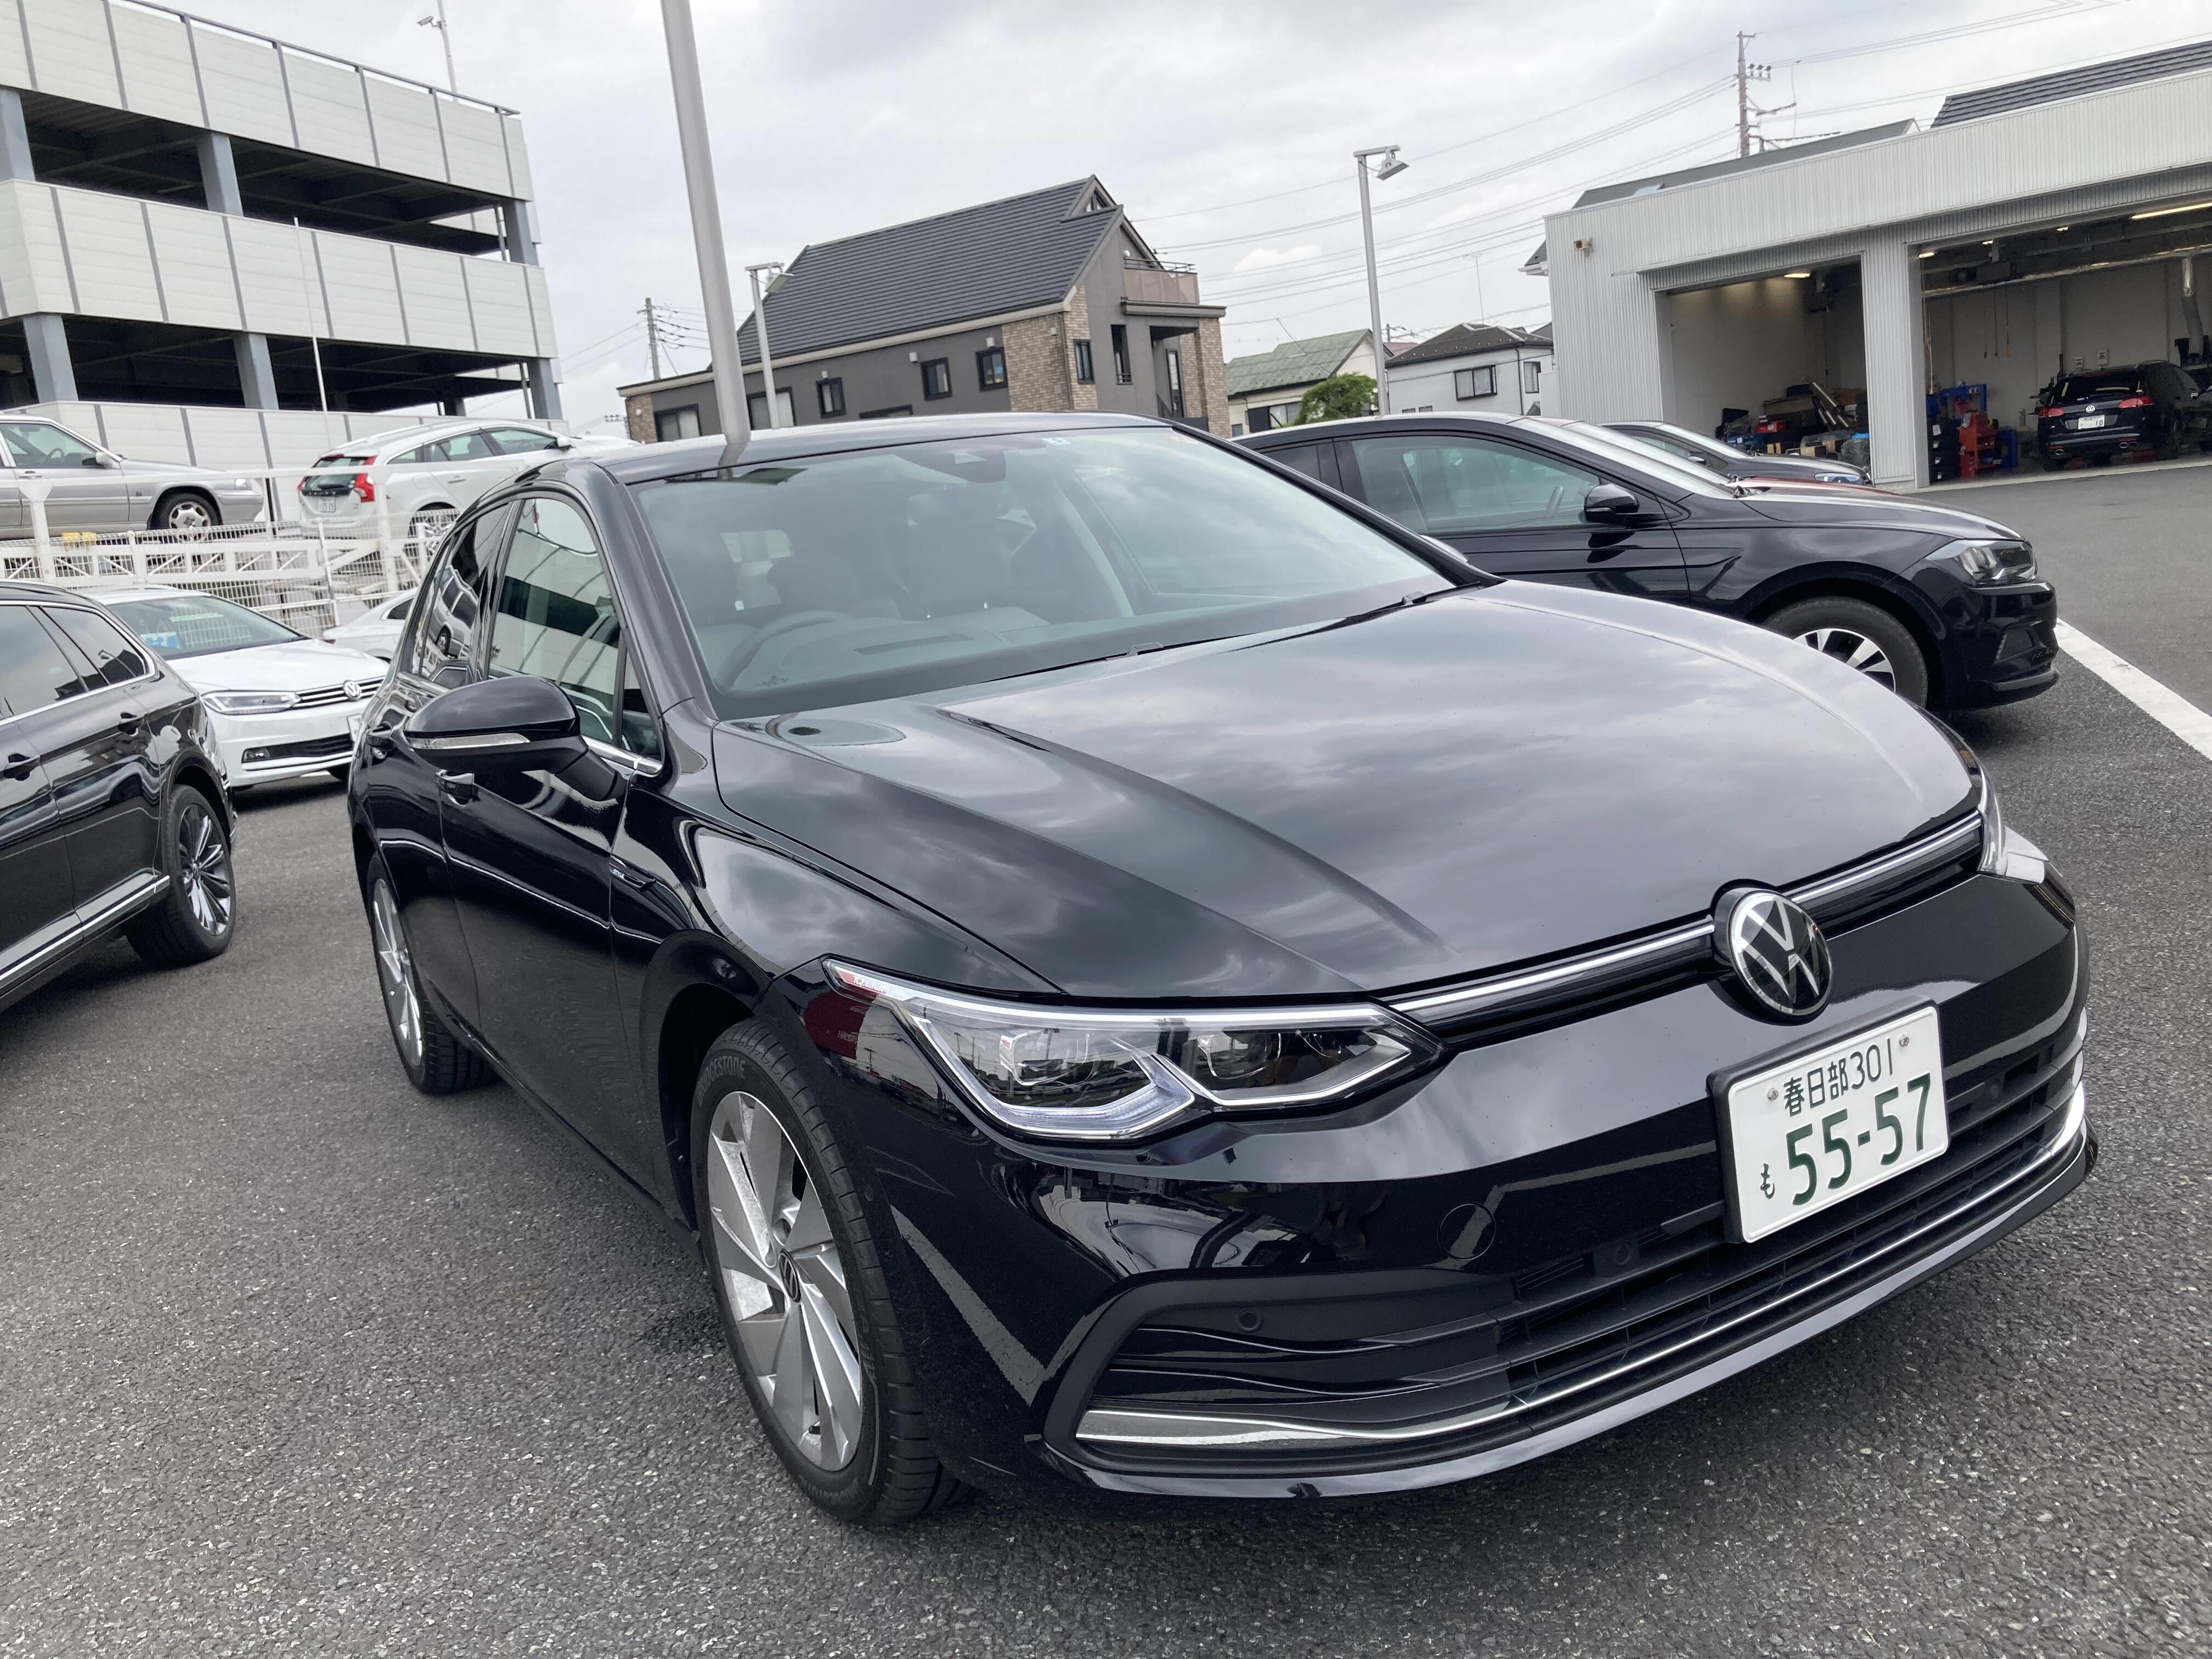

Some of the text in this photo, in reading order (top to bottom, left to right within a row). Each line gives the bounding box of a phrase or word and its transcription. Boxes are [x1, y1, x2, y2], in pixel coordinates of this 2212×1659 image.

[693, 1055, 746, 1108] BRIDGESTONE
[1784, 1037, 1894, 1118] 春日部301
[1760, 1072, 1931, 1205] も 55-57
